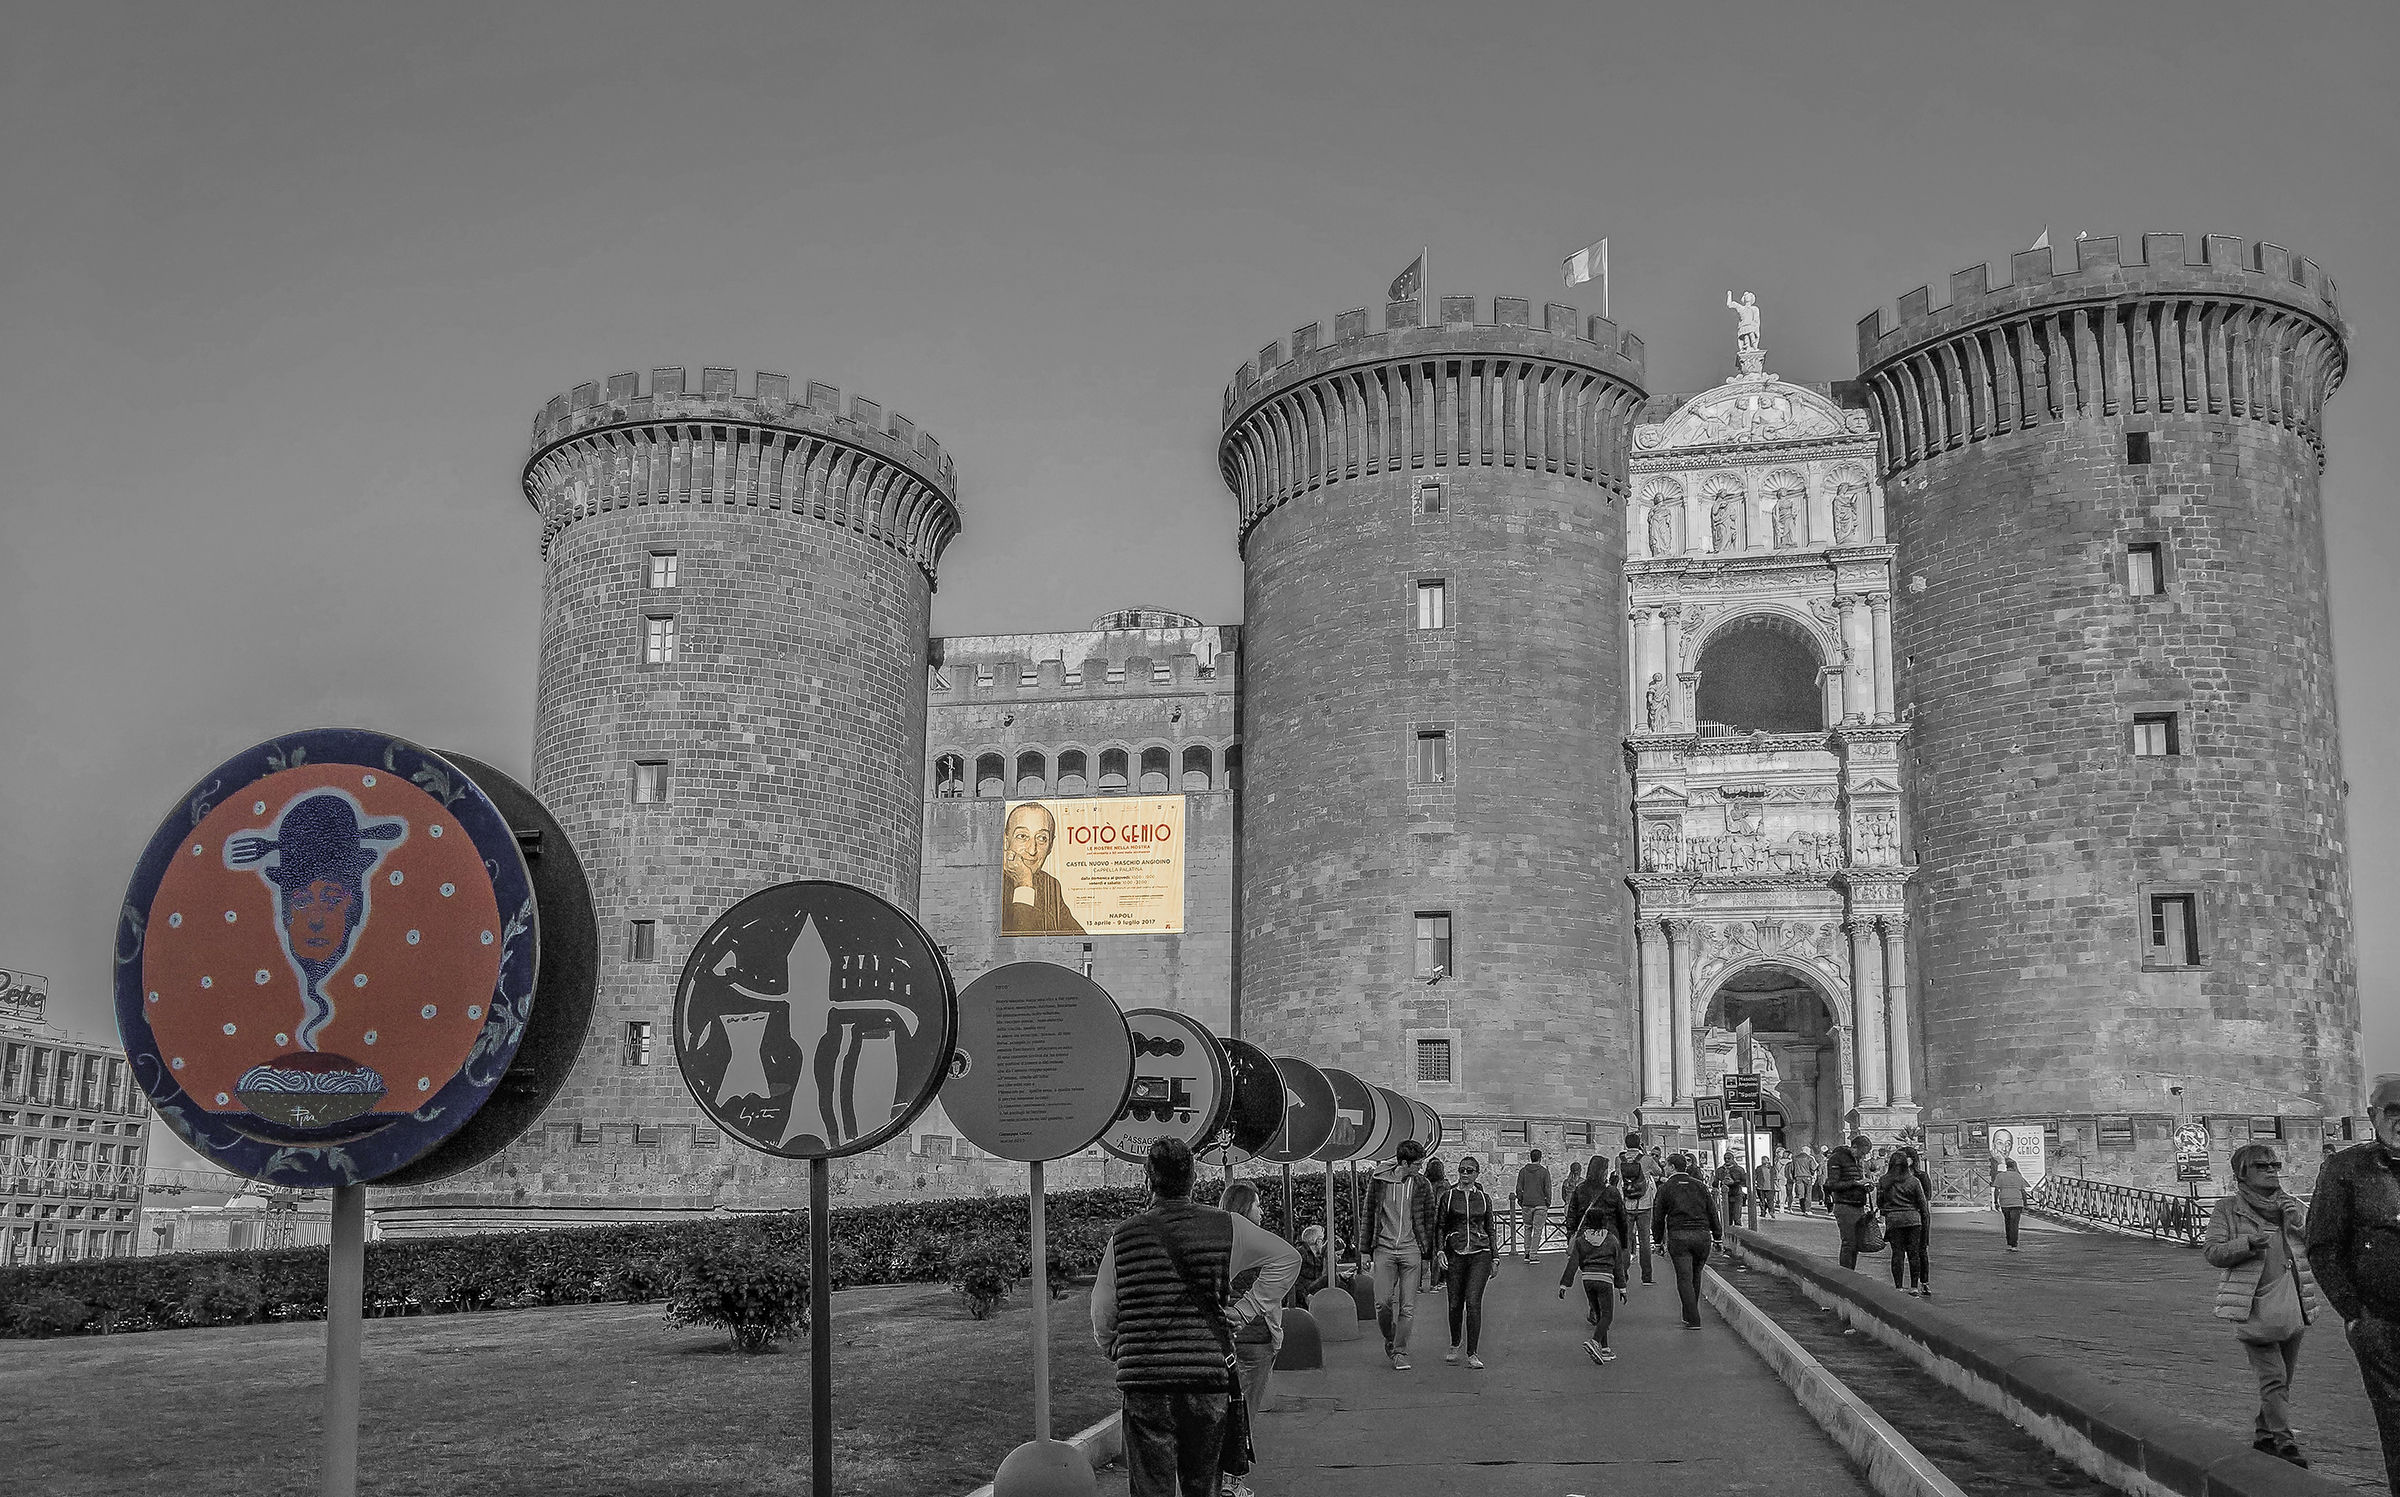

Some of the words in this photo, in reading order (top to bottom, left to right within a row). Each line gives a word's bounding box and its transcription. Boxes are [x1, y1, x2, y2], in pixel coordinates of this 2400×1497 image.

[1067, 822, 1116, 844] TOTÒ
[1121, 824, 1171, 843] GENIO
[1728, 1090, 1735, 1099] P
